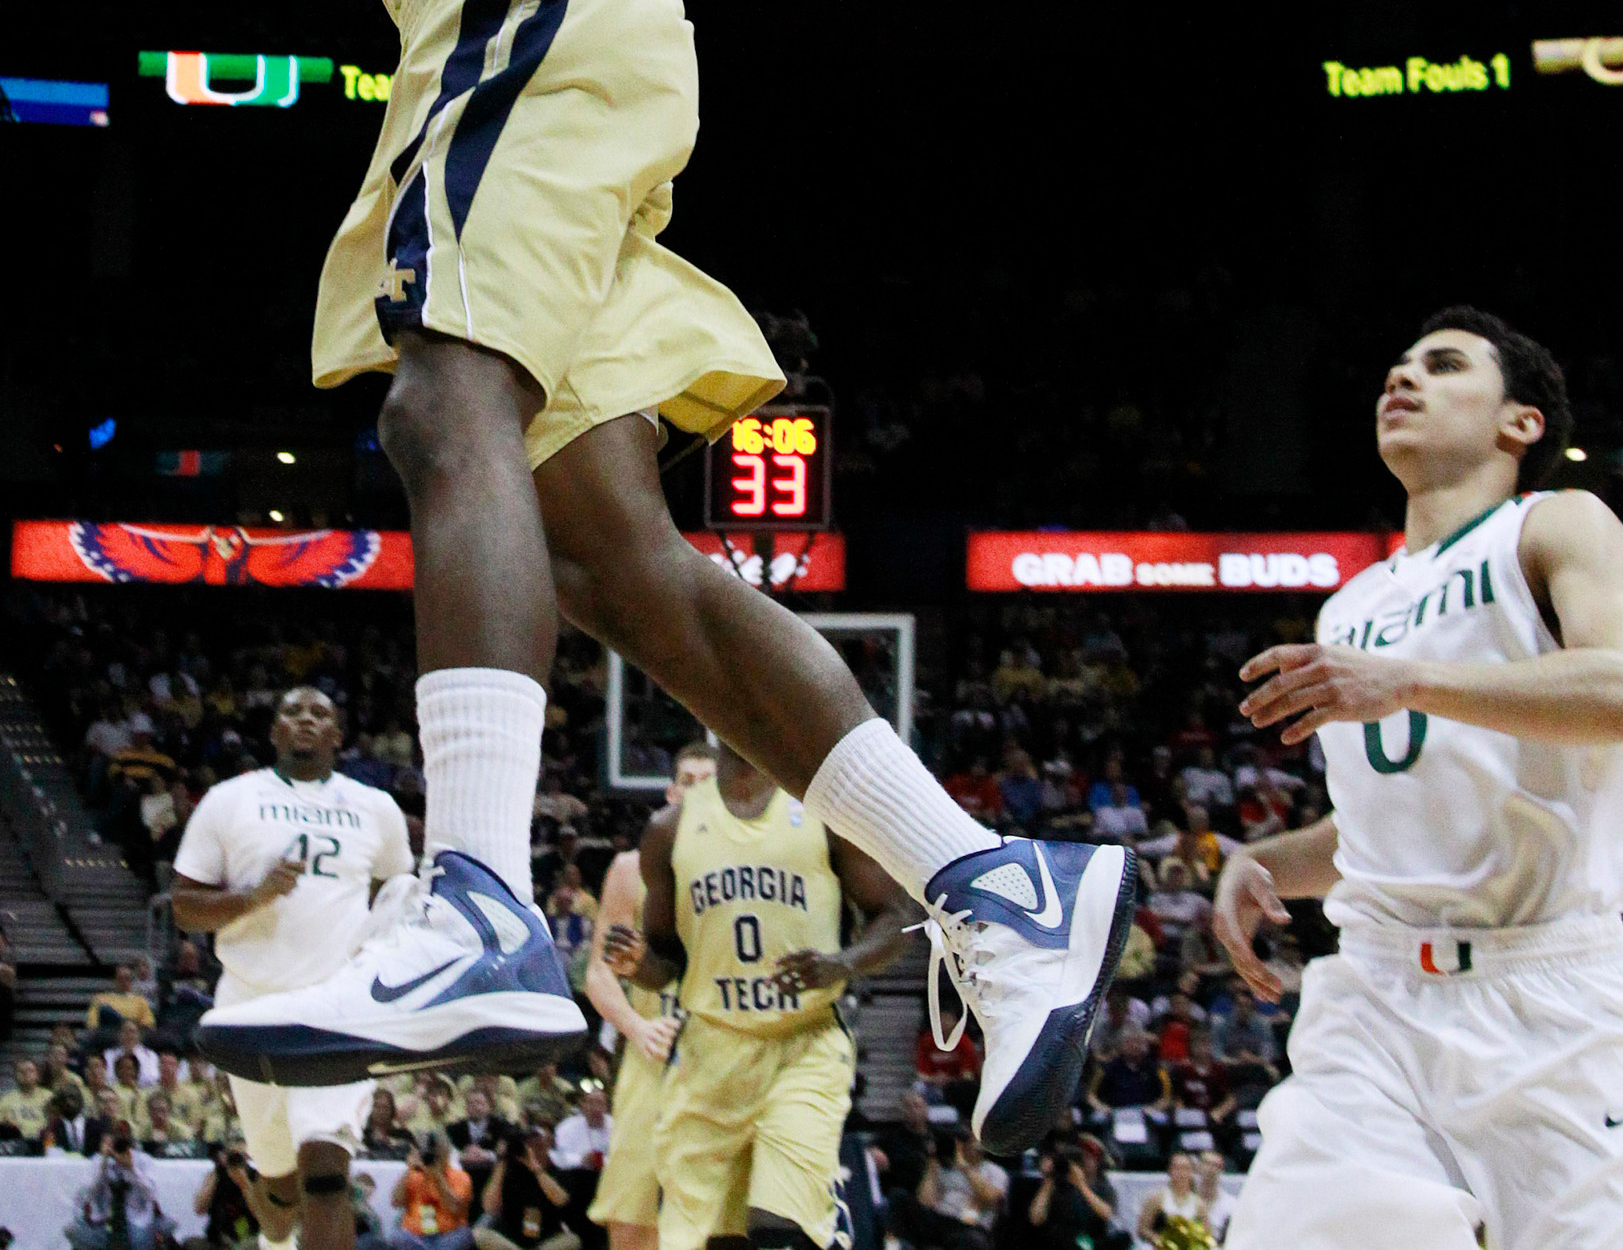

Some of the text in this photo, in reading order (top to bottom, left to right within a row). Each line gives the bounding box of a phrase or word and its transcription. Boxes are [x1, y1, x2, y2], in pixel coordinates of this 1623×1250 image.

[340, 64, 395, 102] Tea
[1323, 52, 1511, 97] Team Fouls 1
[731, 418, 817, 455] 16:06
[731, 454, 807, 517] 33
[1012, 553, 1134, 587] GRAB
[1219, 553, 1341, 588] BUDS
[259, 803, 361, 829] miami
[288, 832, 342, 879] 12
[690, 865, 808, 914] GEORGIA
[735, 914, 763, 964] 0
